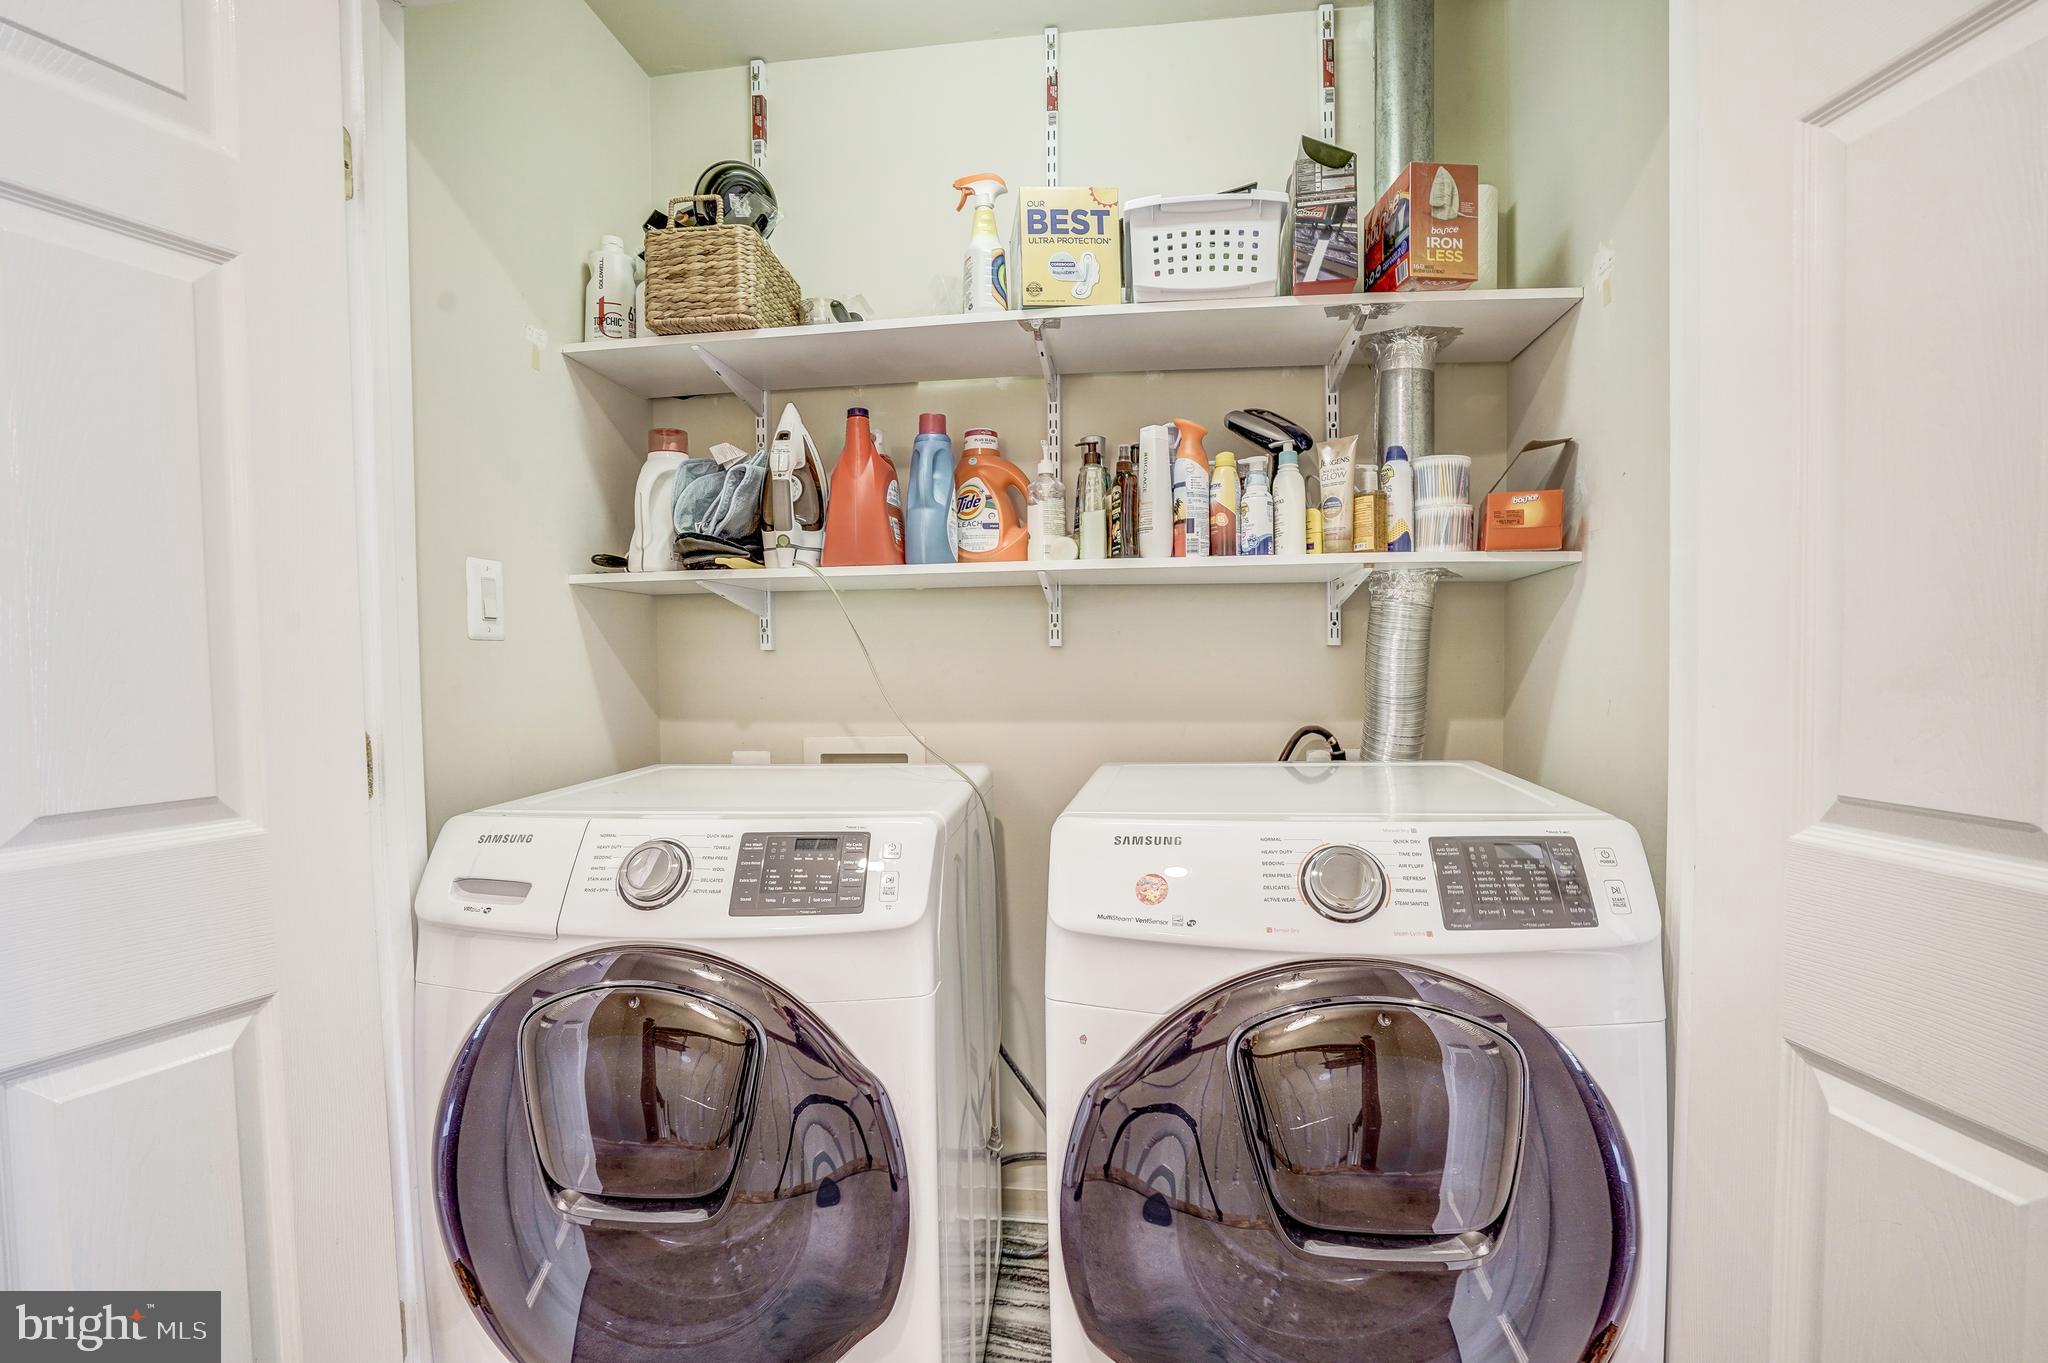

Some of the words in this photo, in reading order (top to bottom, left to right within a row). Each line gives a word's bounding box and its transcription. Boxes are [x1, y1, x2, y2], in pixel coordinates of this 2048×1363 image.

[1027, 209, 1110, 235] BEST
[1431, 226, 1459, 235] bounce
[1426, 236, 1463, 249] IRON
[1427, 249, 1463, 262] LESS
[1321, 471, 1347, 482] GLOW
[957, 494, 981, 514] Tide
[958, 520, 982, 528] LEACH
[478, 834, 534, 844] SAMSUNG
[1113, 835, 1182, 846] SAMSUNG
[1135, 917, 1168, 926] VentSensor
